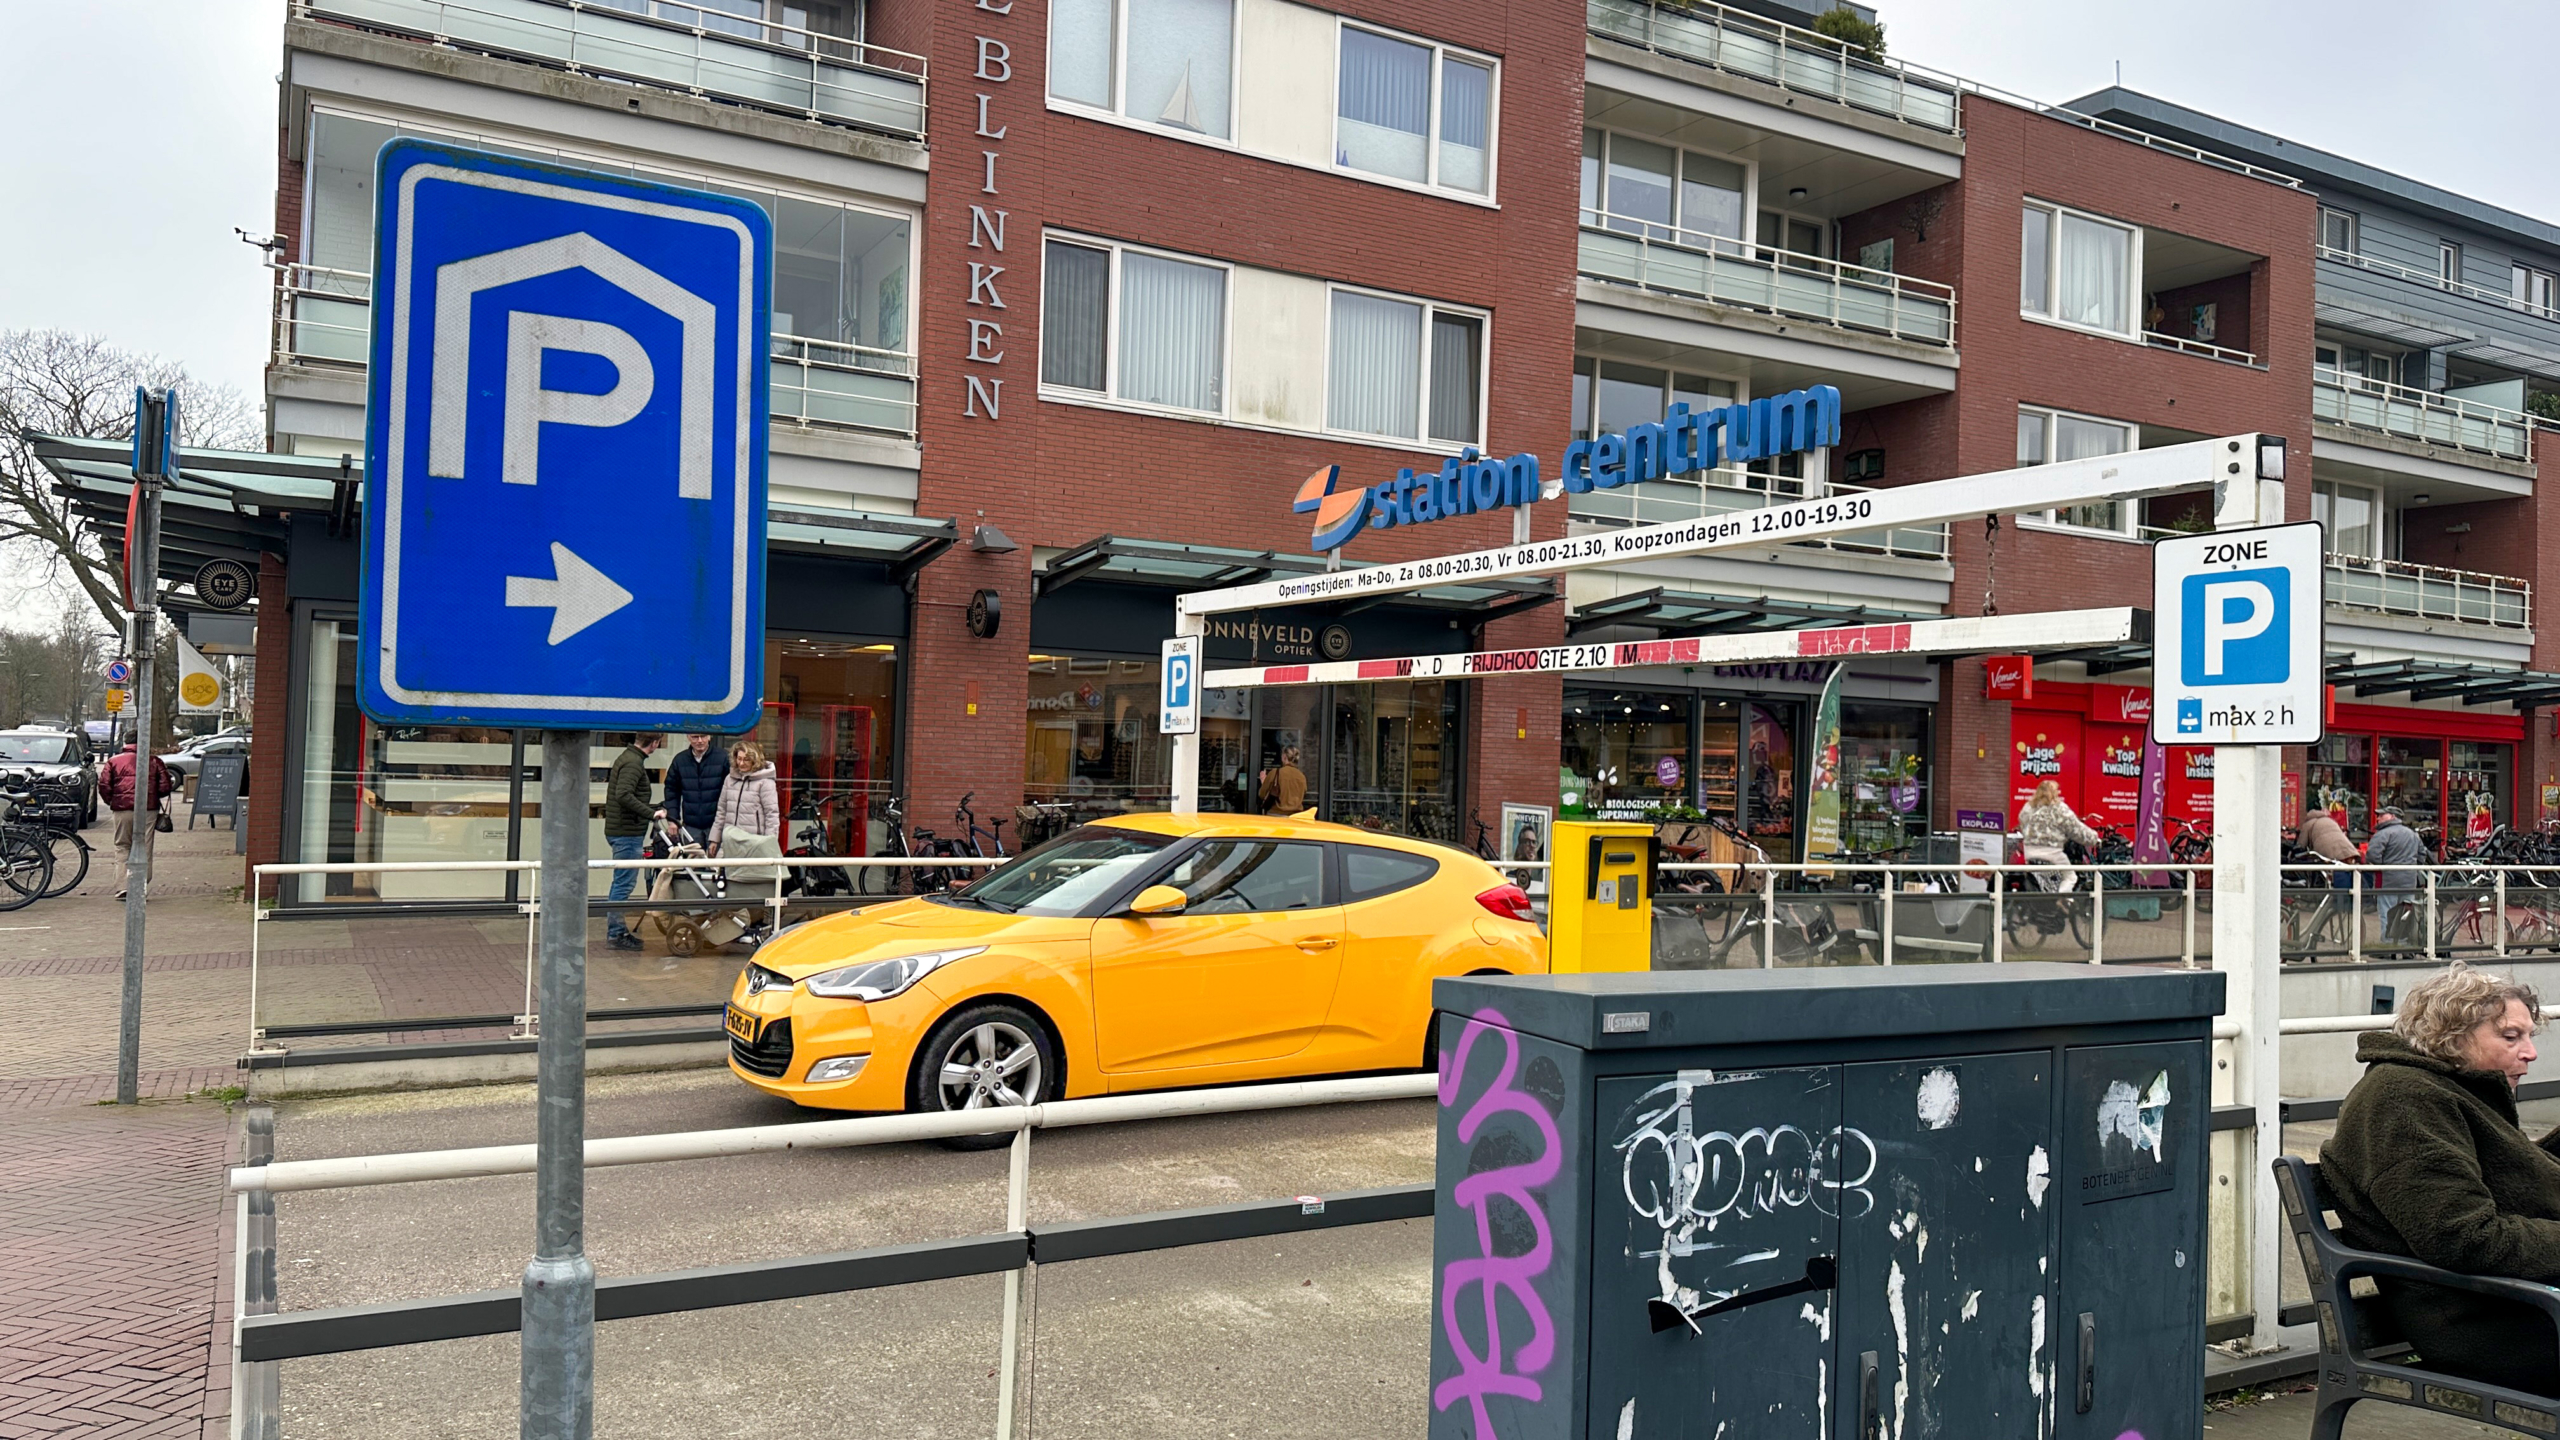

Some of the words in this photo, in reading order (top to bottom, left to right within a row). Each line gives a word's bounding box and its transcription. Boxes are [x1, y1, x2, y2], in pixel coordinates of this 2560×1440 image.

[502, 310, 655, 486] P
[1373, 446, 1539, 529] station
[1562, 384, 1841, 494] centrum
[1279, 577, 1354, 598] Openingstijden:
[1358, 570, 1395, 587] Ma-Do,
[1400, 566, 1414, 581] Za
[1418, 554, 1494, 579] 08.00-20.30,
[1497, 552, 1513, 568] Vr
[1517, 538, 1606, 566] 08.00-21.30,
[1614, 521, 1741, 553] Koopzondagen
[1751, 499, 1873, 533] 12.00-19.30
[2203, 540, 2268, 565] ZONE
[215, 578, 235, 587] EYE
[2204, 580, 2275, 676] P
[1172, 642, 1187, 652] ZONE
[1274, 644, 1313, 656] OPTIEK
[1575, 645, 1607, 667] 2.10
[1712, 661, 1838, 684] EKOPLAZ
[1171, 660, 1188, 703] P
[2209, 709, 2257, 727] max
[2264, 710, 2275, 725] 2
[2281, 704, 2295, 725] h
[2026, 746, 2055, 760] Lage
[2115, 749, 2136, 762] Top
[207, 766, 233, 774] COFFEE
[2020, 760, 2061, 776] prijzen
[2102, 760, 2141, 776] kwalite
[2186, 764, 2214, 778] inslaa
[1606, 799, 1661, 809] BIOLOGISCHE
[1508, 813, 1543, 823] ZONNEVELD
[1597, 809, 1645, 820] SUPERMARK
[1961, 819, 2000, 829] EKOPLAZA
[1614, 1016, 1646, 1028] STAKA
